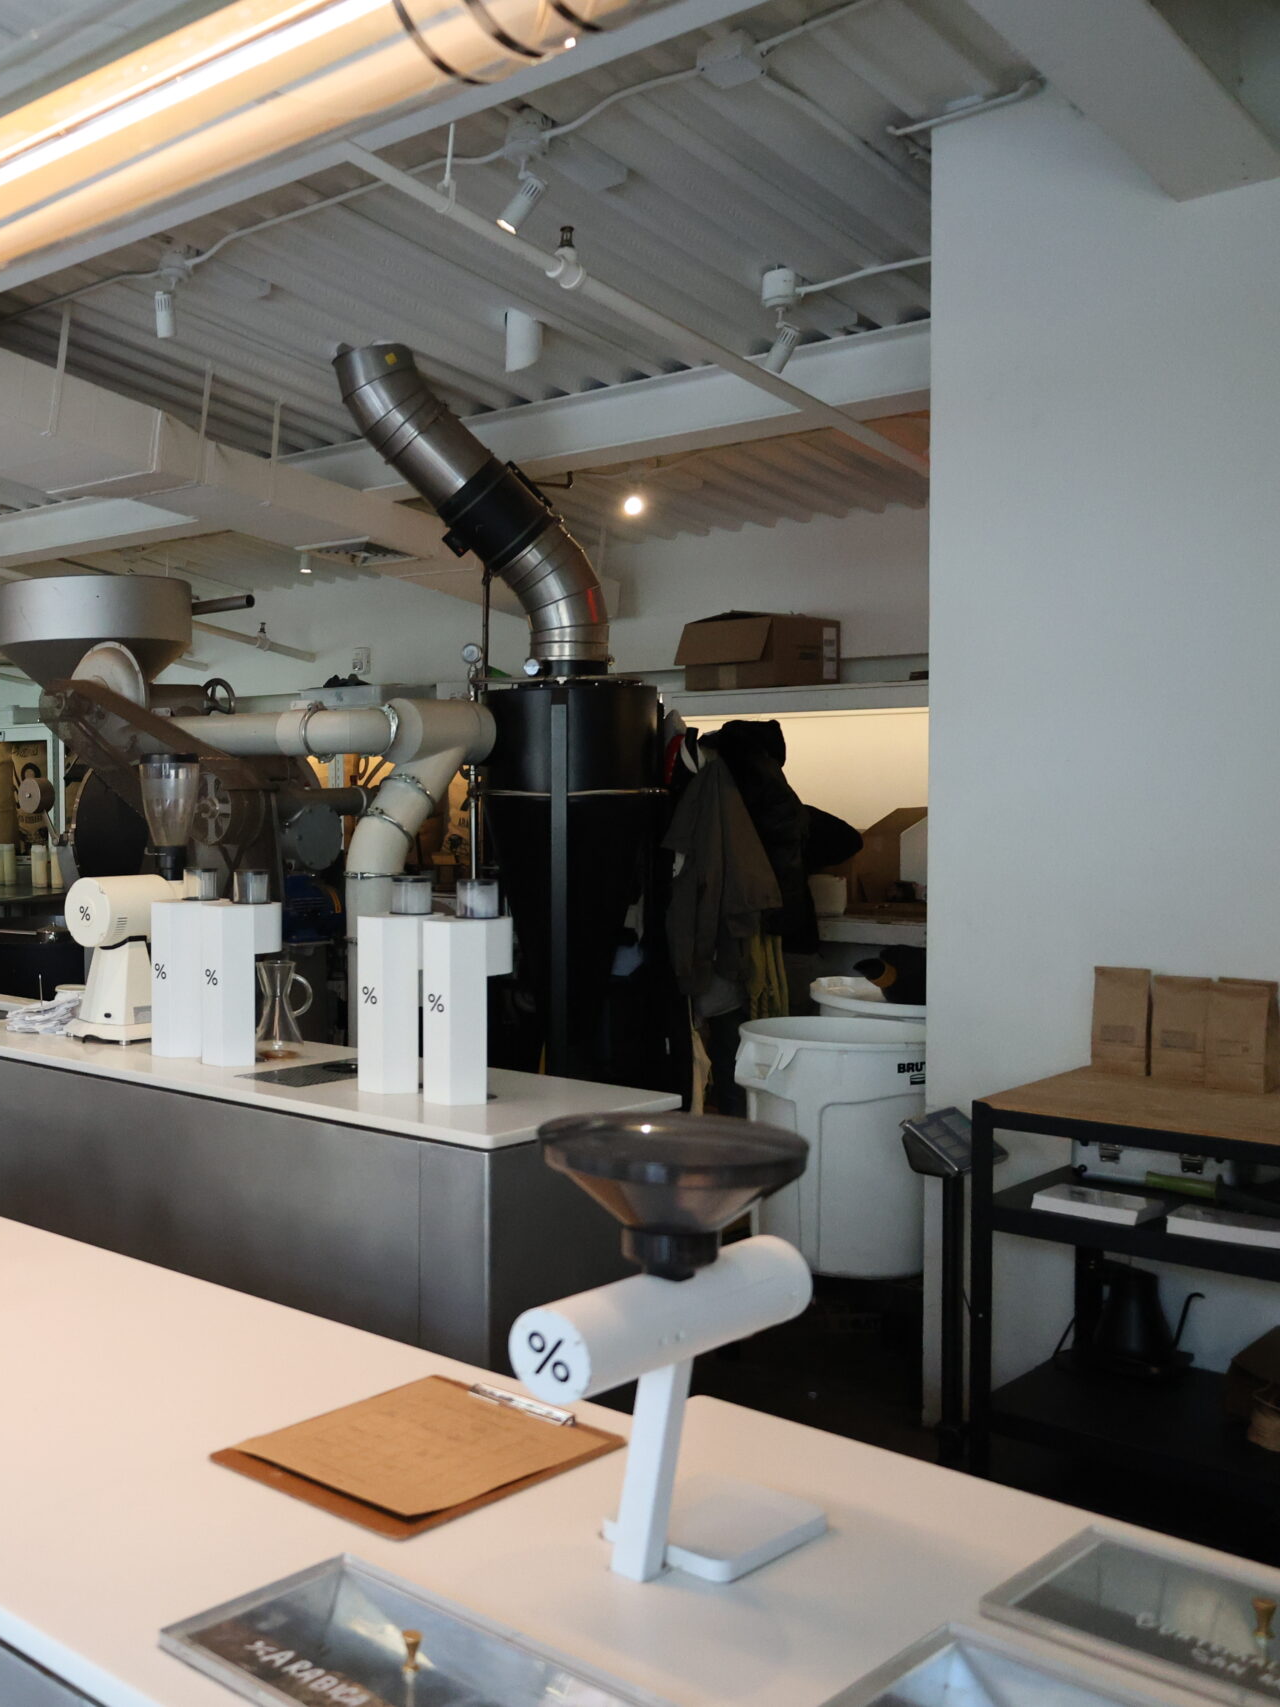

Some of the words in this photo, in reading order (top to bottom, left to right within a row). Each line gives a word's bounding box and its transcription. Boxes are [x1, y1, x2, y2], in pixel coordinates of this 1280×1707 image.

[79, 905, 91, 922] %
[154, 962, 167, 980] %
[205, 968, 218, 986] %
[362, 986, 378, 1005] %
[427, 993, 445, 1013] %
[528, 1331, 570, 1383] %
